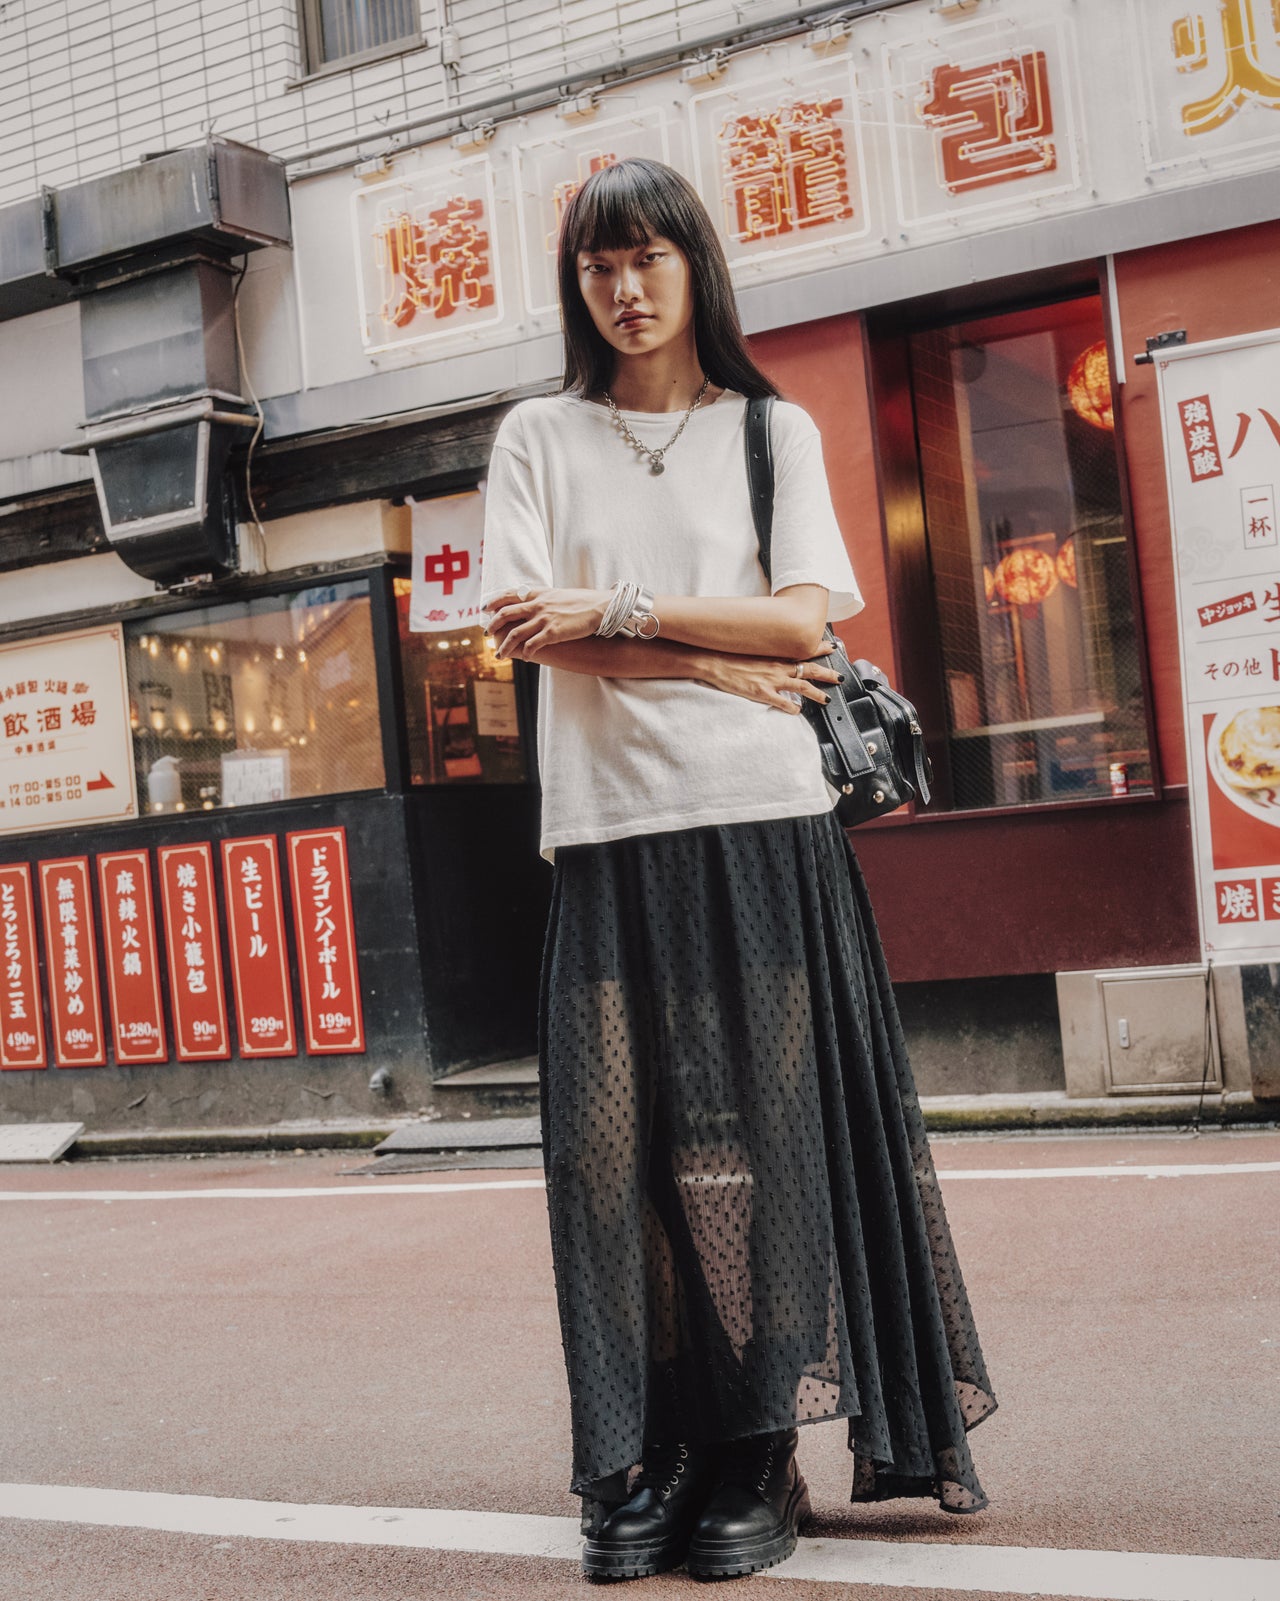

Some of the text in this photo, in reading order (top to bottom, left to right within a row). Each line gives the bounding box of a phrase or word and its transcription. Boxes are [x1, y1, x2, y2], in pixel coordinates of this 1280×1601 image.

[372, 50, 1057, 326] 焼籠包
[1184, 400, 1221, 476] 強炭酸
[1247, 496, 1272, 538] 一杯
[1200, 596, 1254, 623] 中ジョッキ
[1204, 657, 1262, 681] その他
[1, 883, 27, 1020] とろとろカニ玉
[55, 877, 85, 1016] 無限青菜炒め
[115, 870, 142, 976] 麻辣火鍋
[176, 863, 208, 994] 焼き小籠包
[241, 856, 268, 958] 生ビール
[310, 846, 341, 1000] ドラゴンハイボール
